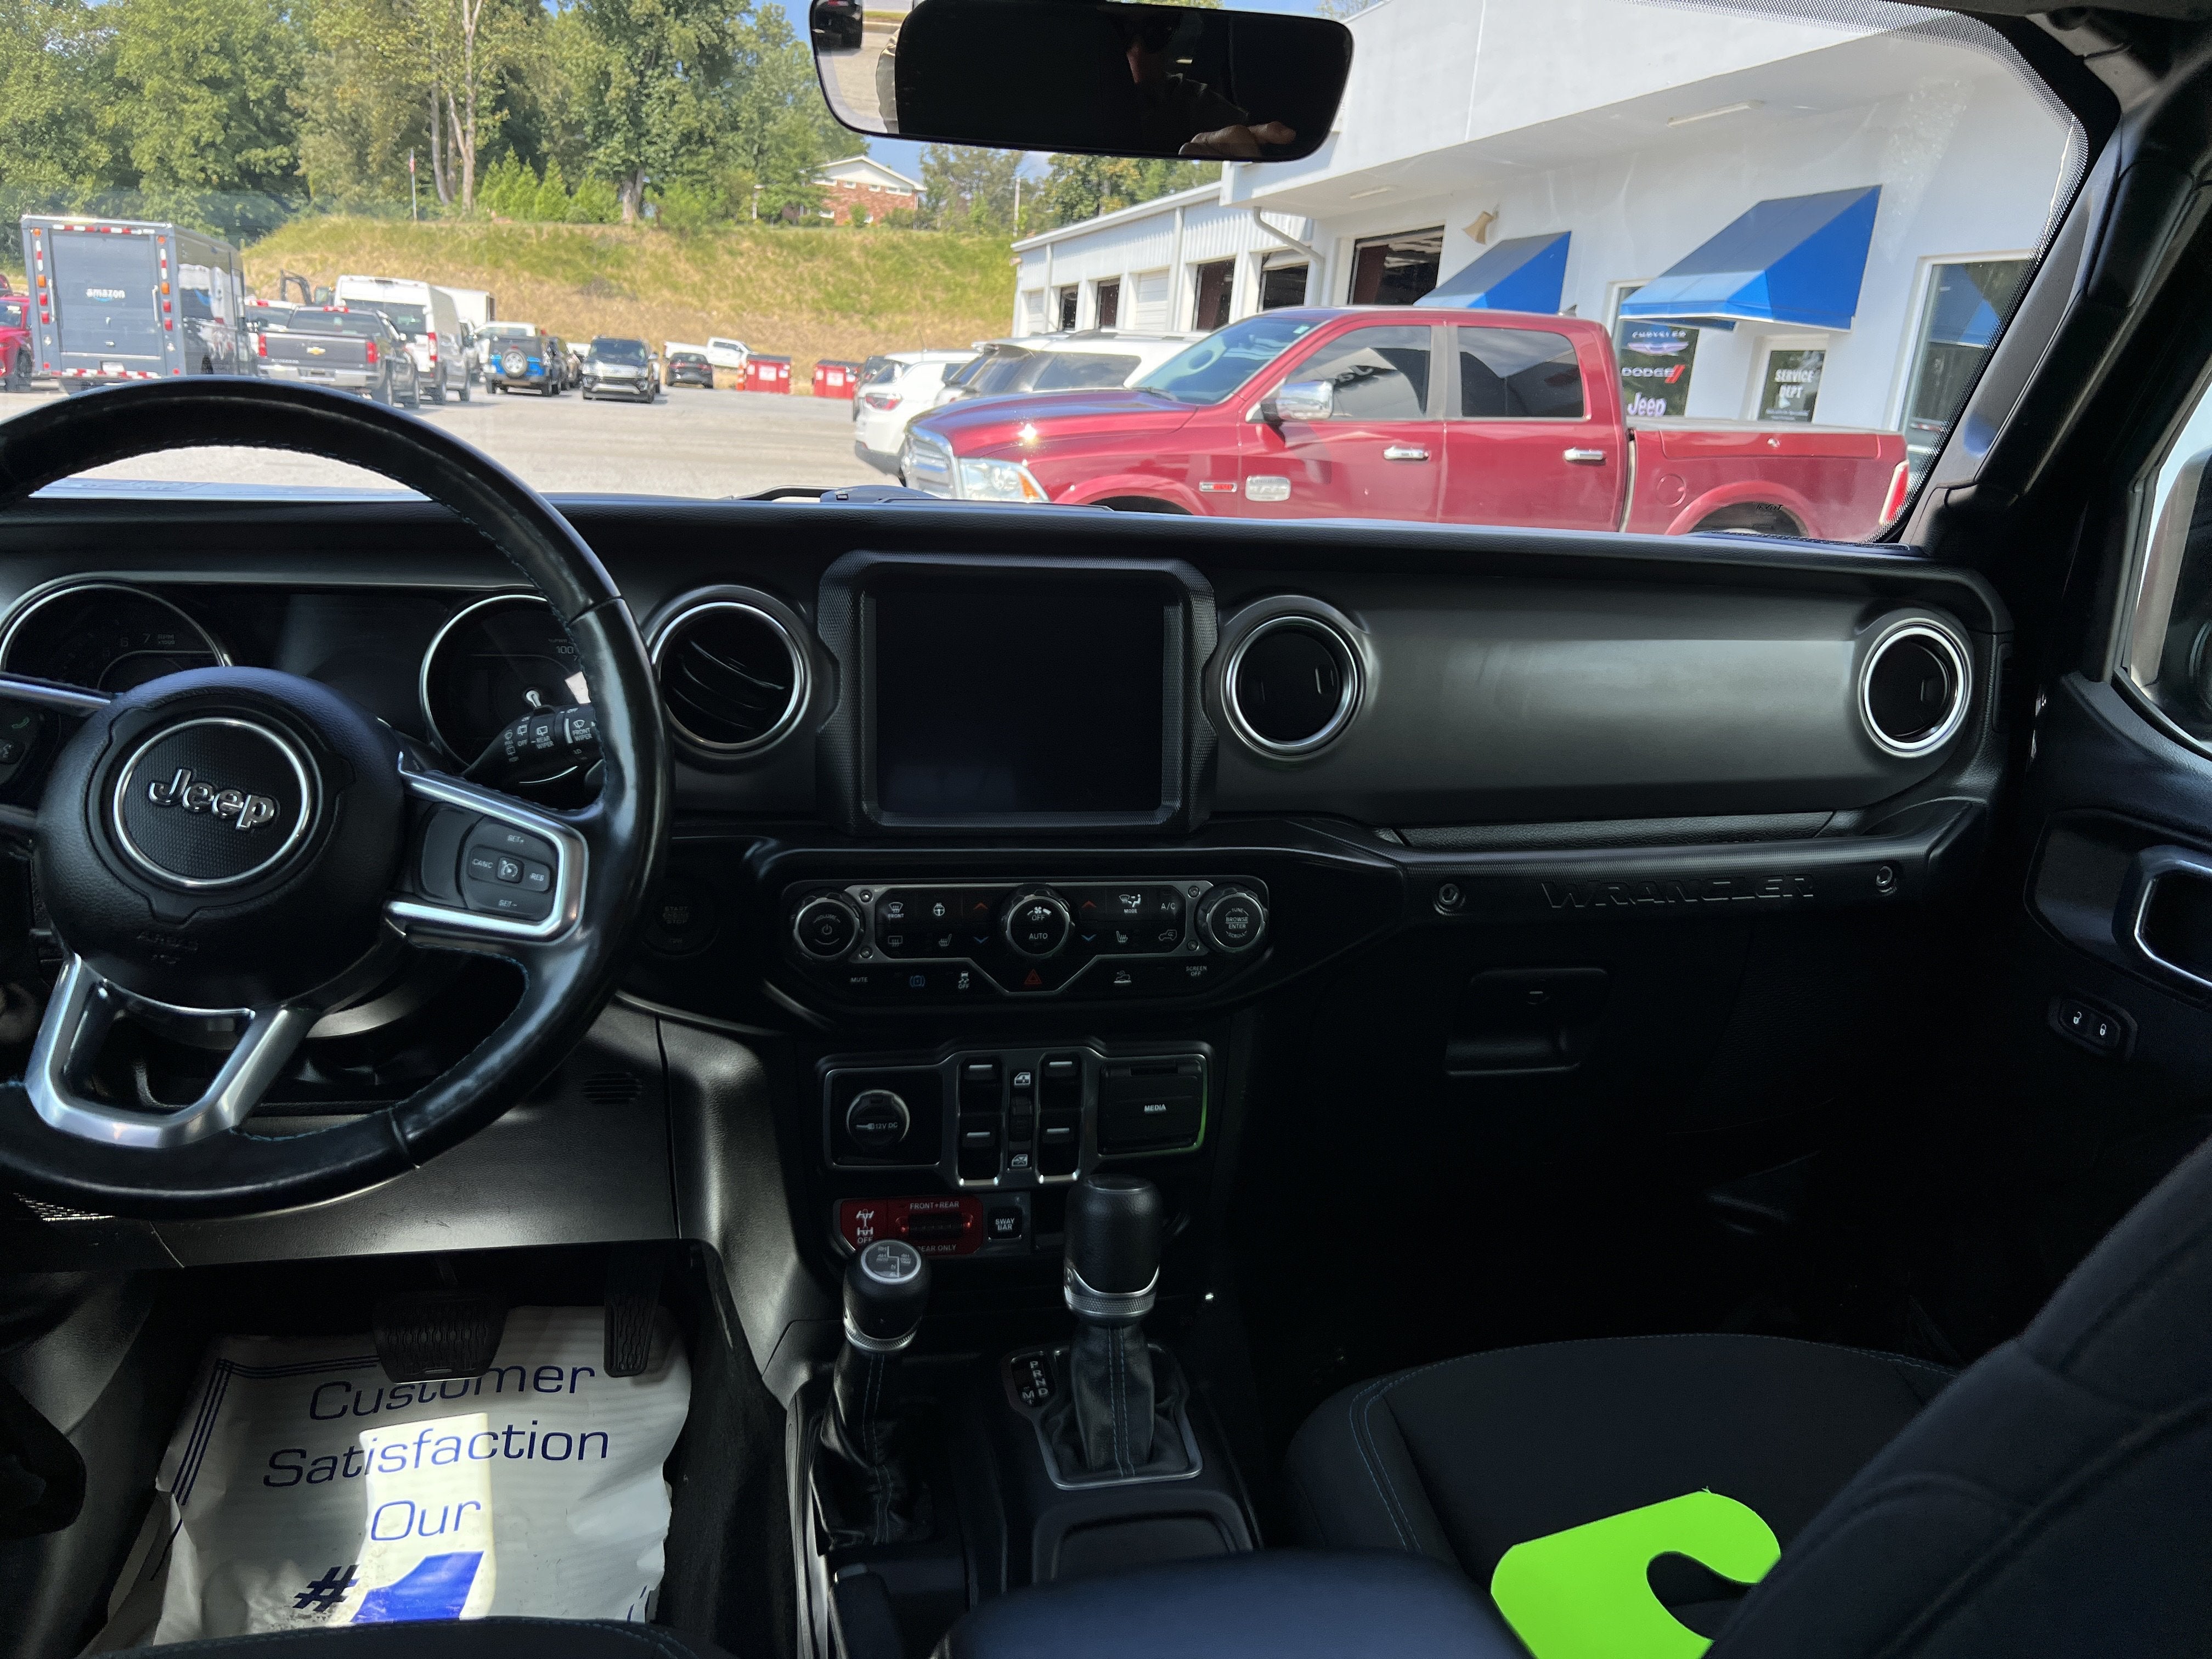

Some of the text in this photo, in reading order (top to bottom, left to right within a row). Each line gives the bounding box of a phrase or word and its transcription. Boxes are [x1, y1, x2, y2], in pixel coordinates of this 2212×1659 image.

[86, 289, 125, 299] amazon
[1622, 367, 1675, 377] DODGE
[1775, 369, 1814, 382] SERVICE
[1779, 385, 1803, 398] DEPT
[1628, 392, 1667, 417] Jeep
[143, 633, 151, 644] 7
[556, 646, 574, 654] 100
[148, 768, 276, 830] Jeep
[472, 859, 493, 868] CANC
[1539, 873, 1814, 909] WRANGLER
[1161, 902, 1176, 911] A/C
[1144, 1103, 1167, 1112] MEDIA
[1030, 1361, 1039, 1369] P
[309, 1364, 595, 1421] Customer
[1022, 1390, 1035, 1399] M
[1038, 1388, 1048, 1398] D
[263, 1420, 610, 1487] Satisfaction
[370, 1500, 481, 1541] Our
